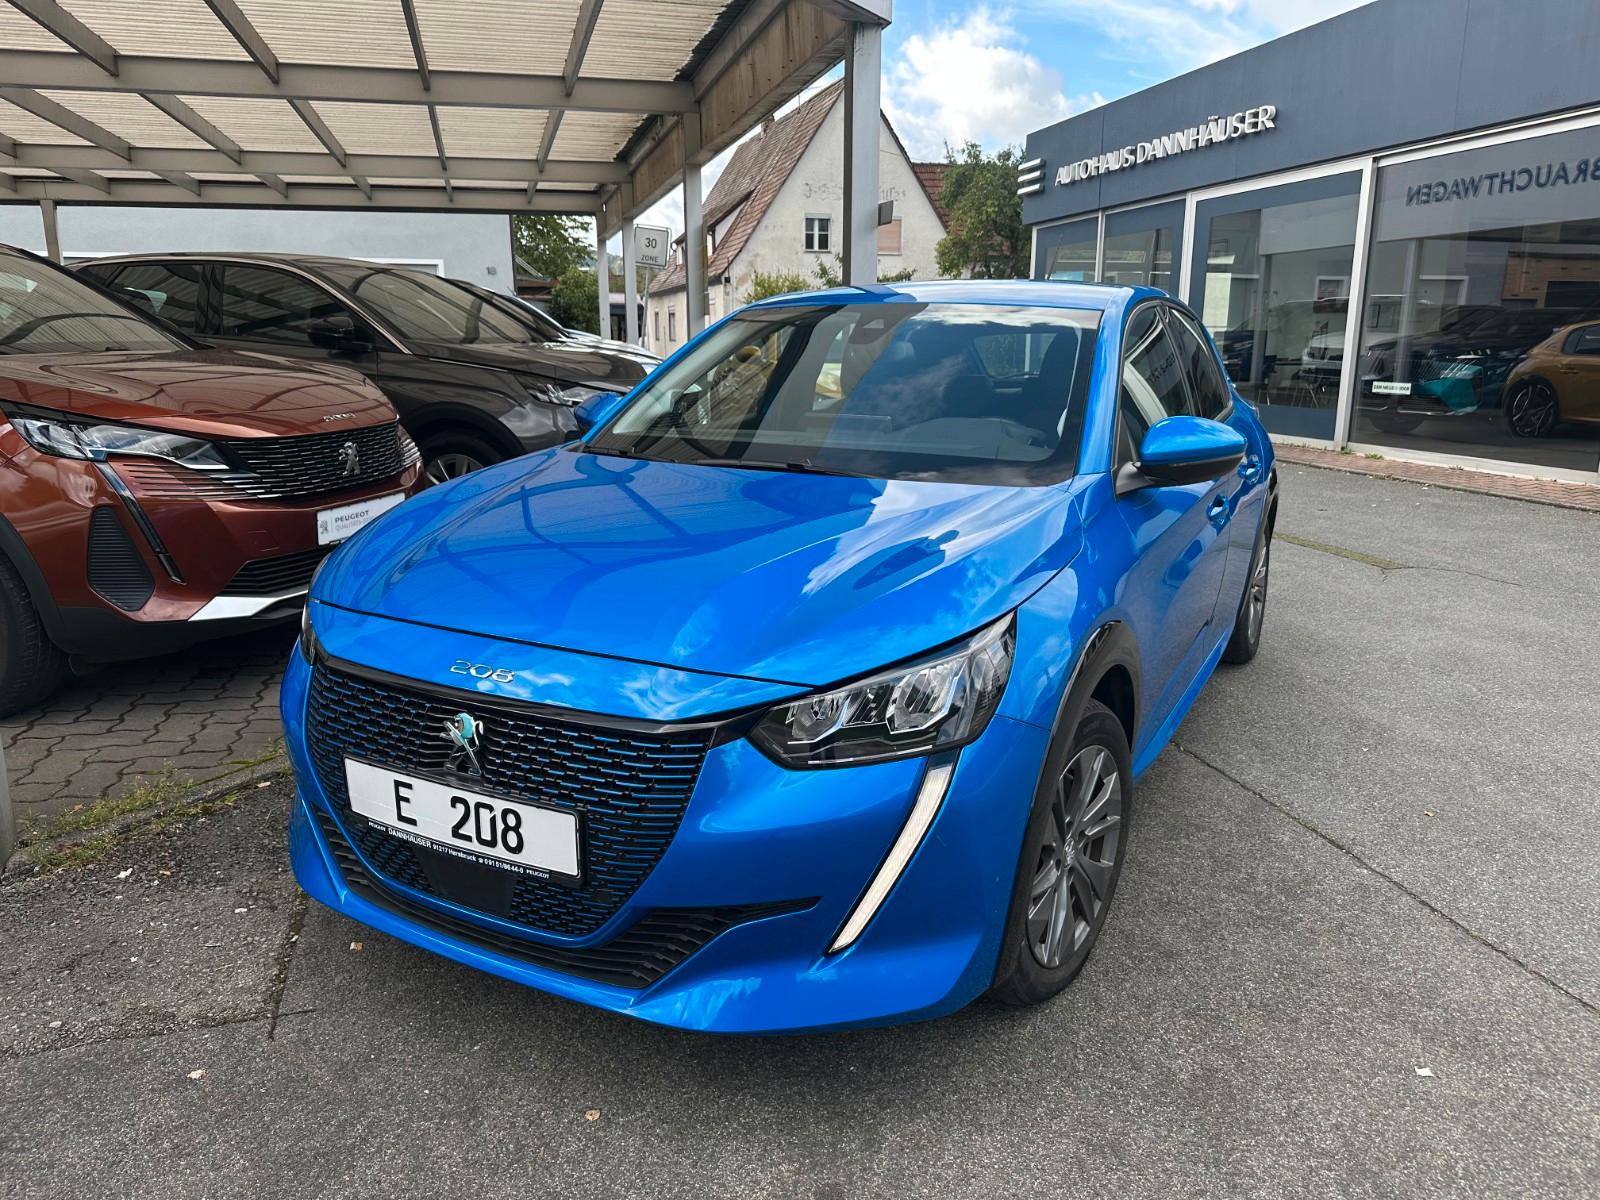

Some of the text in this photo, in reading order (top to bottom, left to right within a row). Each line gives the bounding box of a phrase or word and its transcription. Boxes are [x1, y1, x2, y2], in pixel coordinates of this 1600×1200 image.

[1055, 105, 1278, 187] AUTOHAUS DANNHÄUSER
[645, 237, 657, 249] 30
[640, 254, 660, 263] ZONE
[334, 510, 369, 524] PEUGEOT
[450, 660, 515, 683] 208
[393, 779, 524, 855] E 208
[448, 848, 477, 862] Hersbruck
